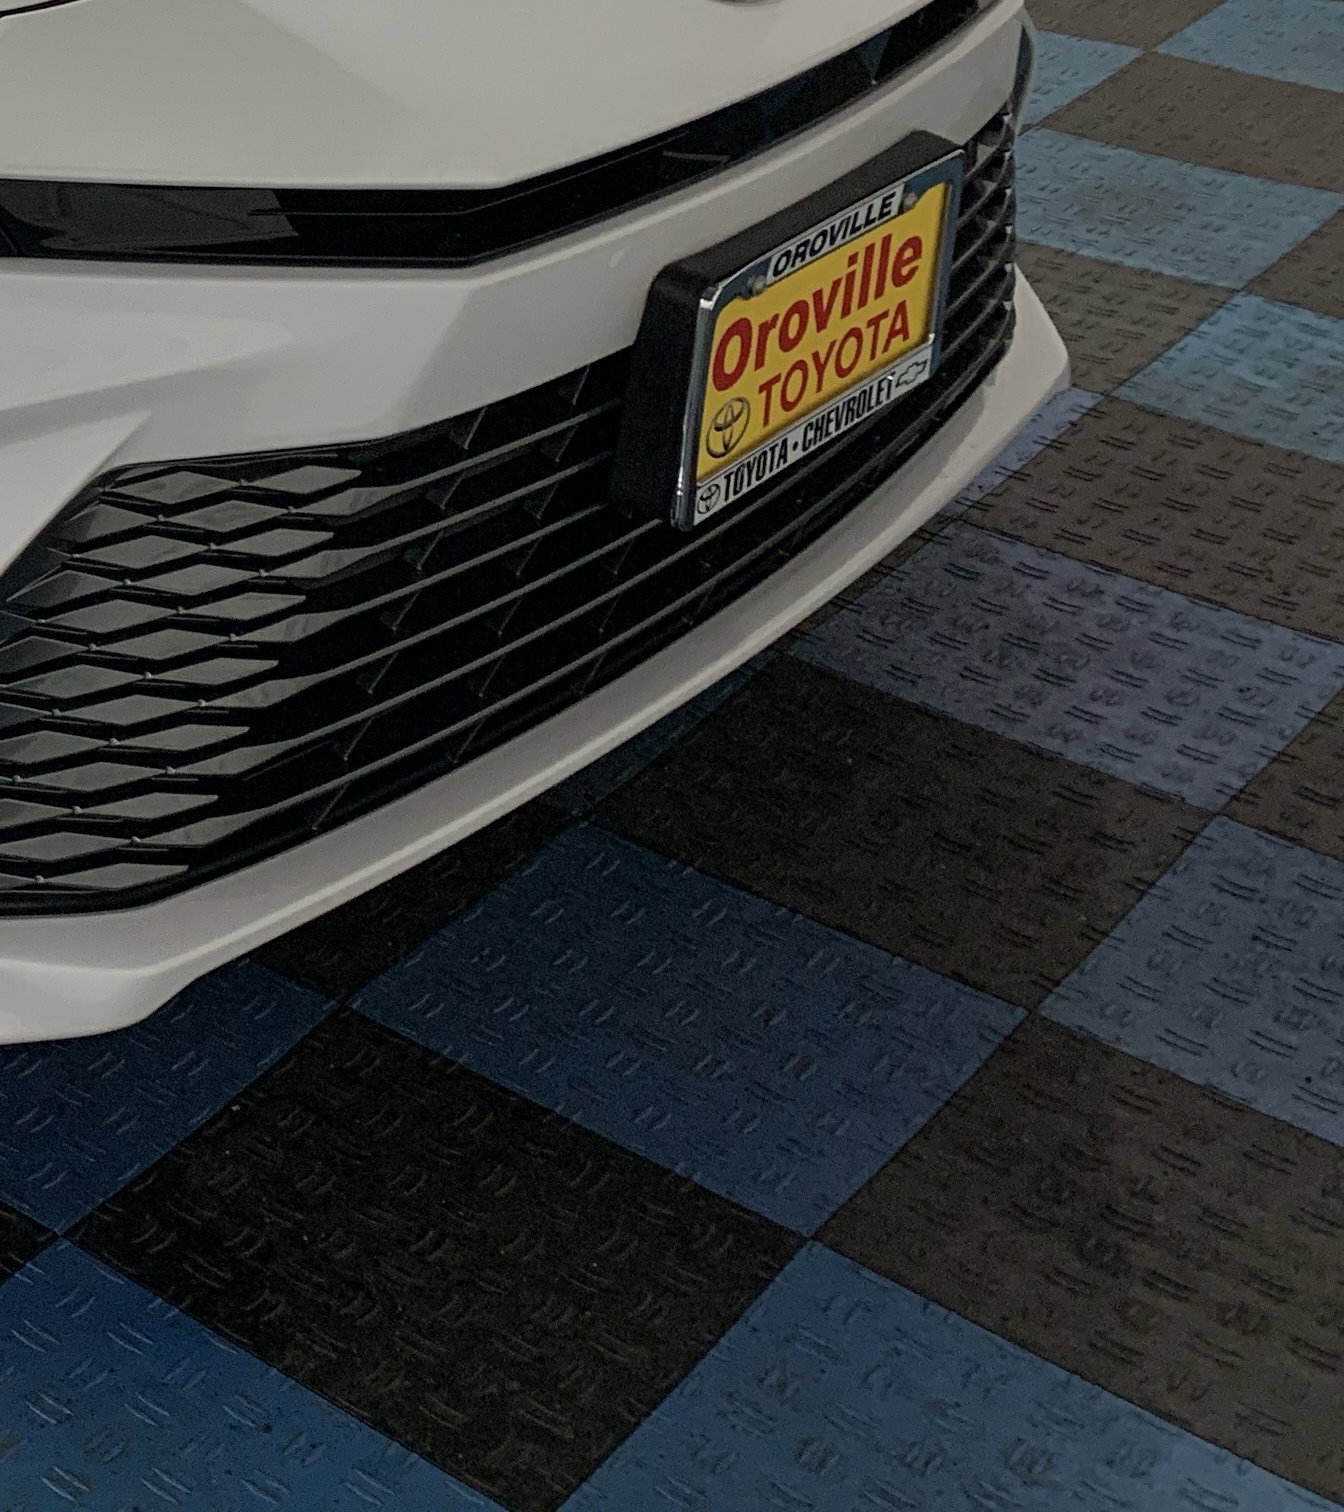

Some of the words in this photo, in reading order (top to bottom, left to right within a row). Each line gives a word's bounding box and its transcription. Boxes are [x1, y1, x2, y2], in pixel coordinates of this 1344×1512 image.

[772, 191, 897, 278] OROVILLE
[712, 233, 923, 392] Oroville
[758, 299, 911, 428] TOYOTA
[723, 437, 789, 502] TOYOTA
[801, 371, 896, 453] CHEVROLET
